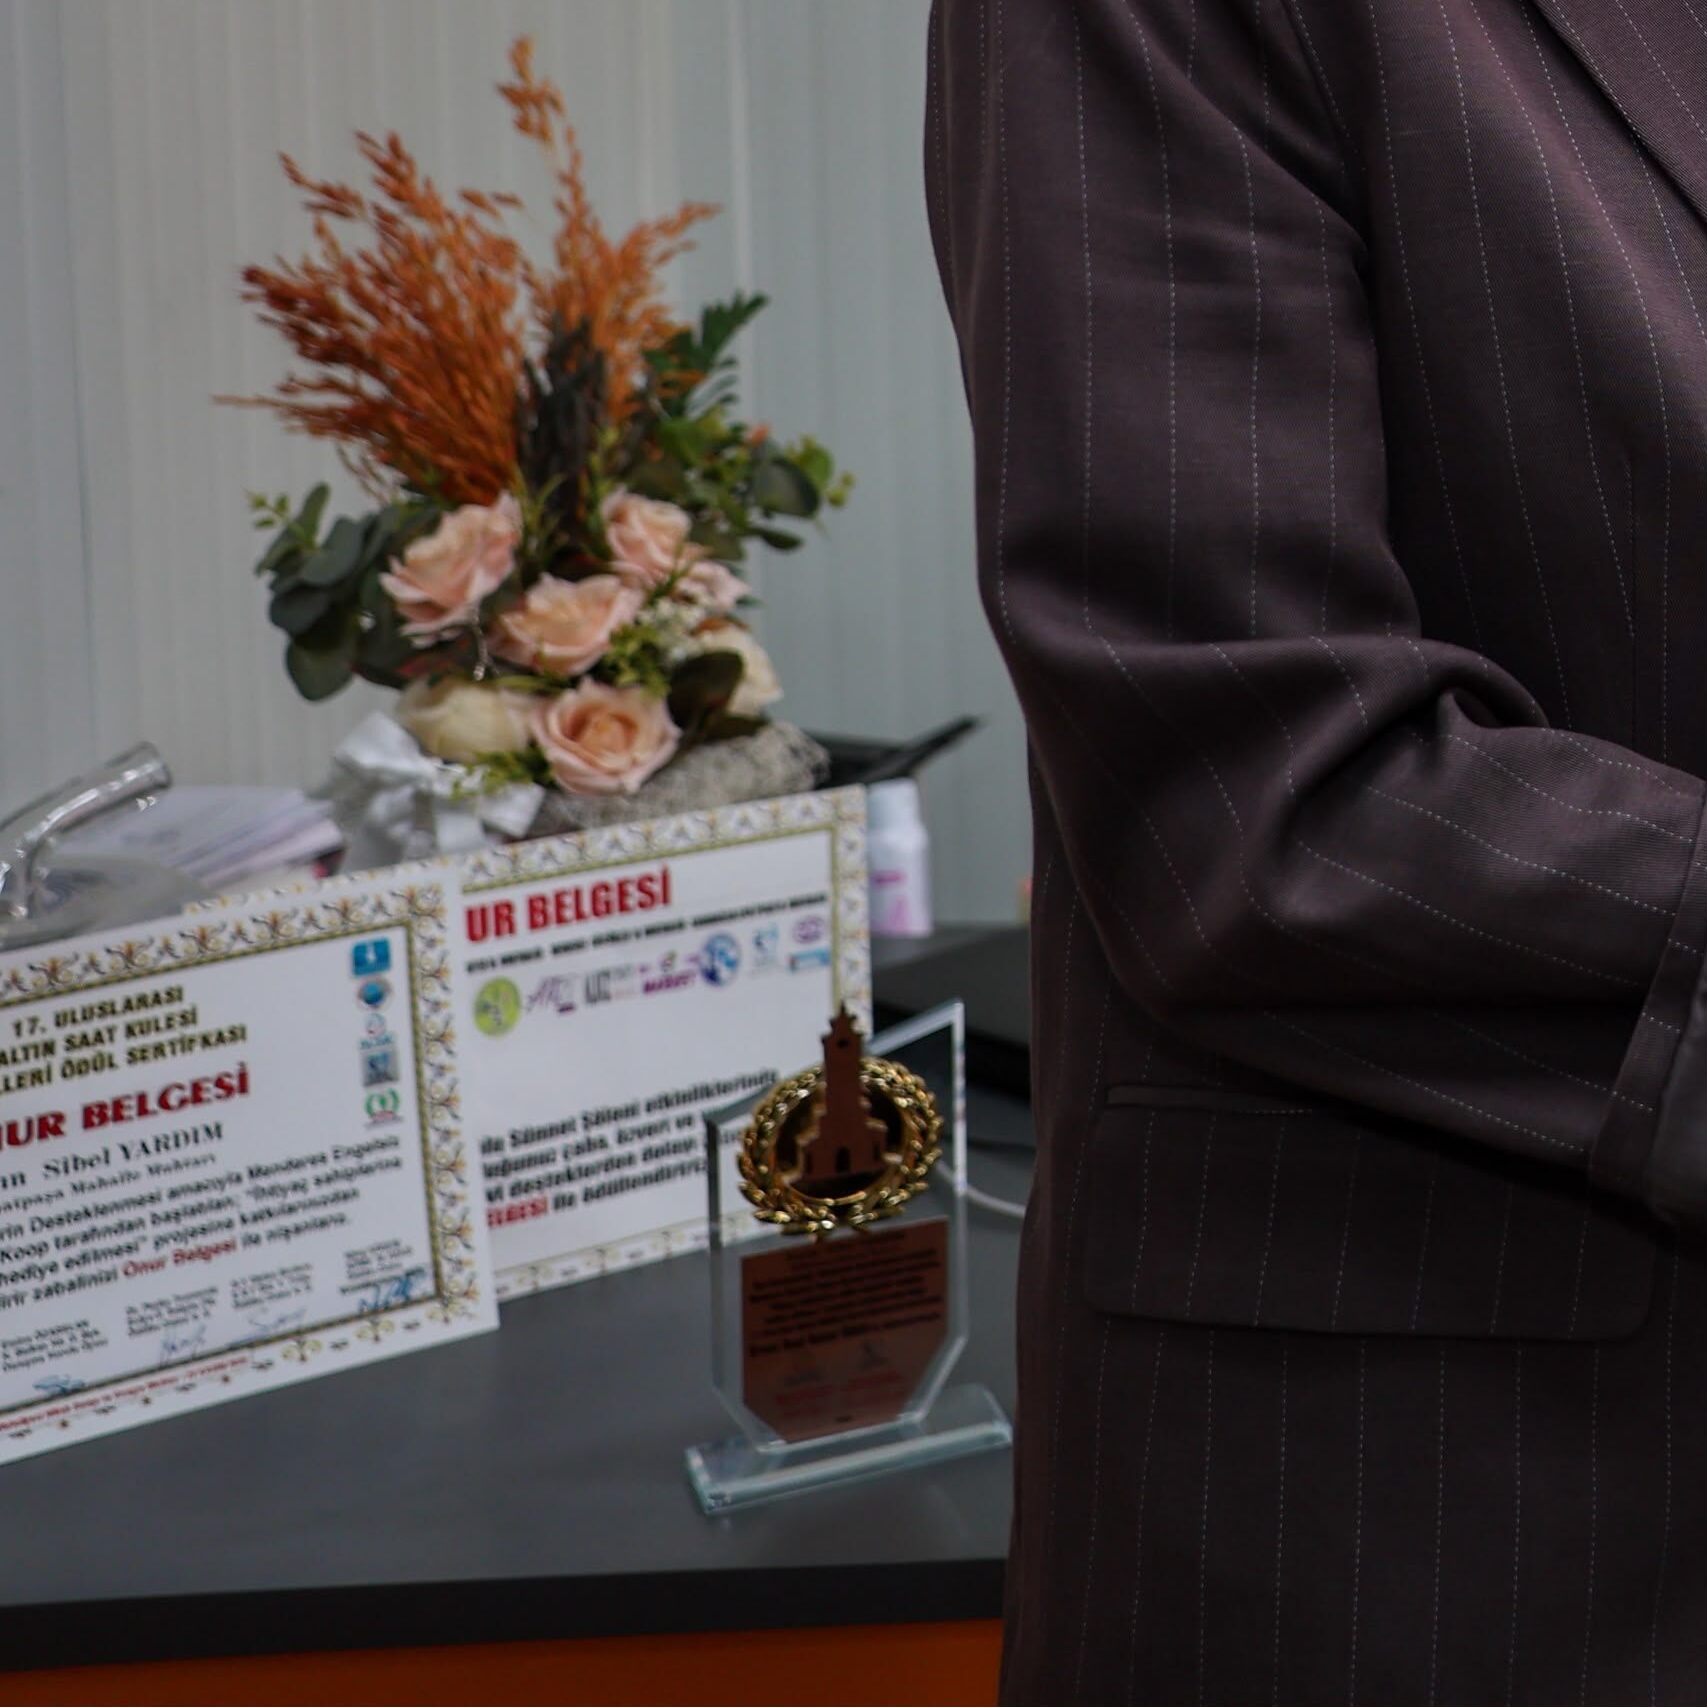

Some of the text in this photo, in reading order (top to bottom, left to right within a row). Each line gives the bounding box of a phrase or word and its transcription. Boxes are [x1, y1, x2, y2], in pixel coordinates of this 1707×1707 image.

[465, 899, 517, 943] UR
[528, 863, 671, 931] BELGESİ
[0, 1004, 198, 1065] ALTIN SAAT KULESİ
[13, 985, 184, 1037] 17. ULUSLARASI
[61, 1050, 118, 1079] ÖDÜL
[0, 1061, 250, 1151] UR BELGESİ
[43, 1146, 110, 1179] Sibel
[118, 1121, 223, 1161] YARDIM
[30, 1189, 162, 1233] Desteklenmesi
[54, 1217, 146, 1250] tarafından
[123, 1255, 167, 1277] Onur
[173, 1239, 236, 1265] Belgesi
